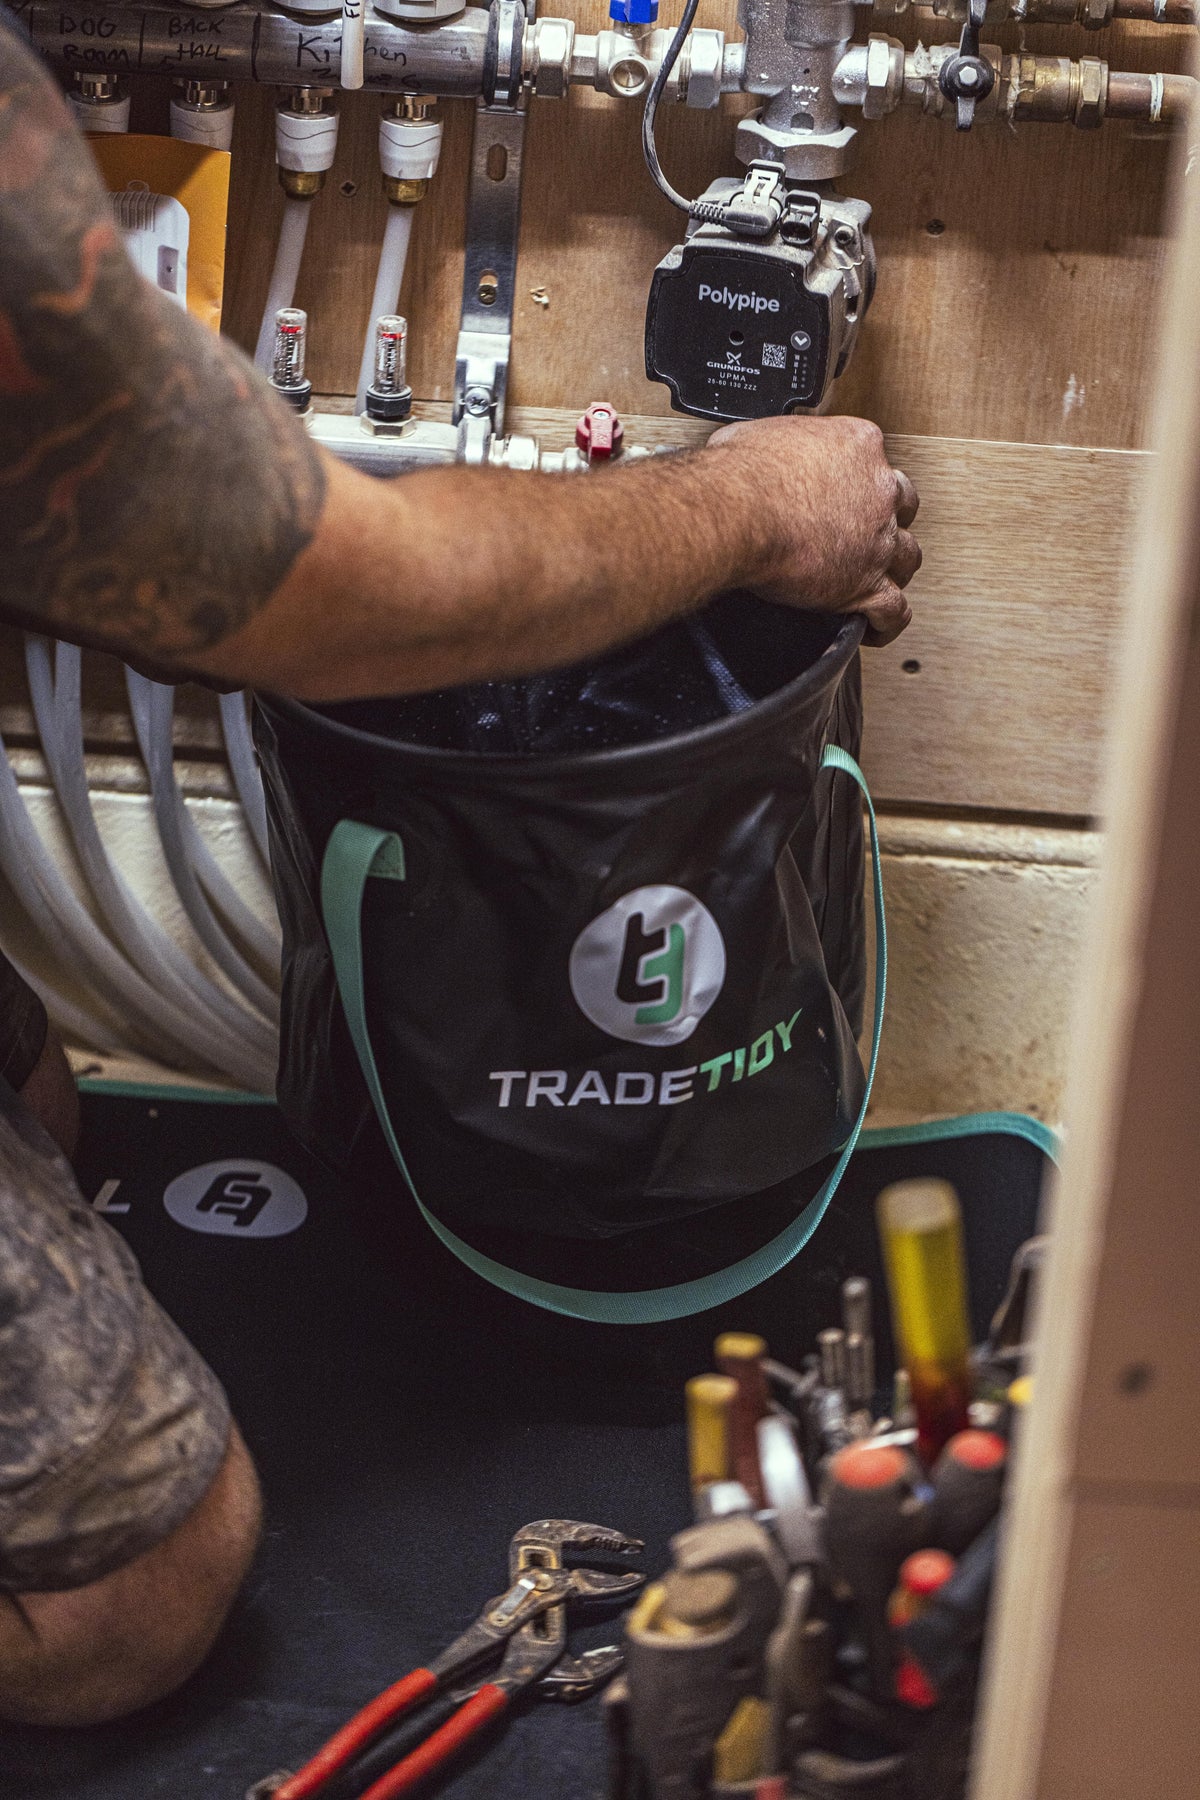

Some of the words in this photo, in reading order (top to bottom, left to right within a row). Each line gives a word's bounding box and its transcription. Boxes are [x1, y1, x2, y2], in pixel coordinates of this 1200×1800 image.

[60, 13, 117, 37] DOG
[168, 17, 225, 38] BACK
[177, 42, 228, 62] HALL
[698, 284, 780, 314] Polypipe
[706, 360, 761, 375] GRUNDFOS
[719, 371, 747, 382] UPMA
